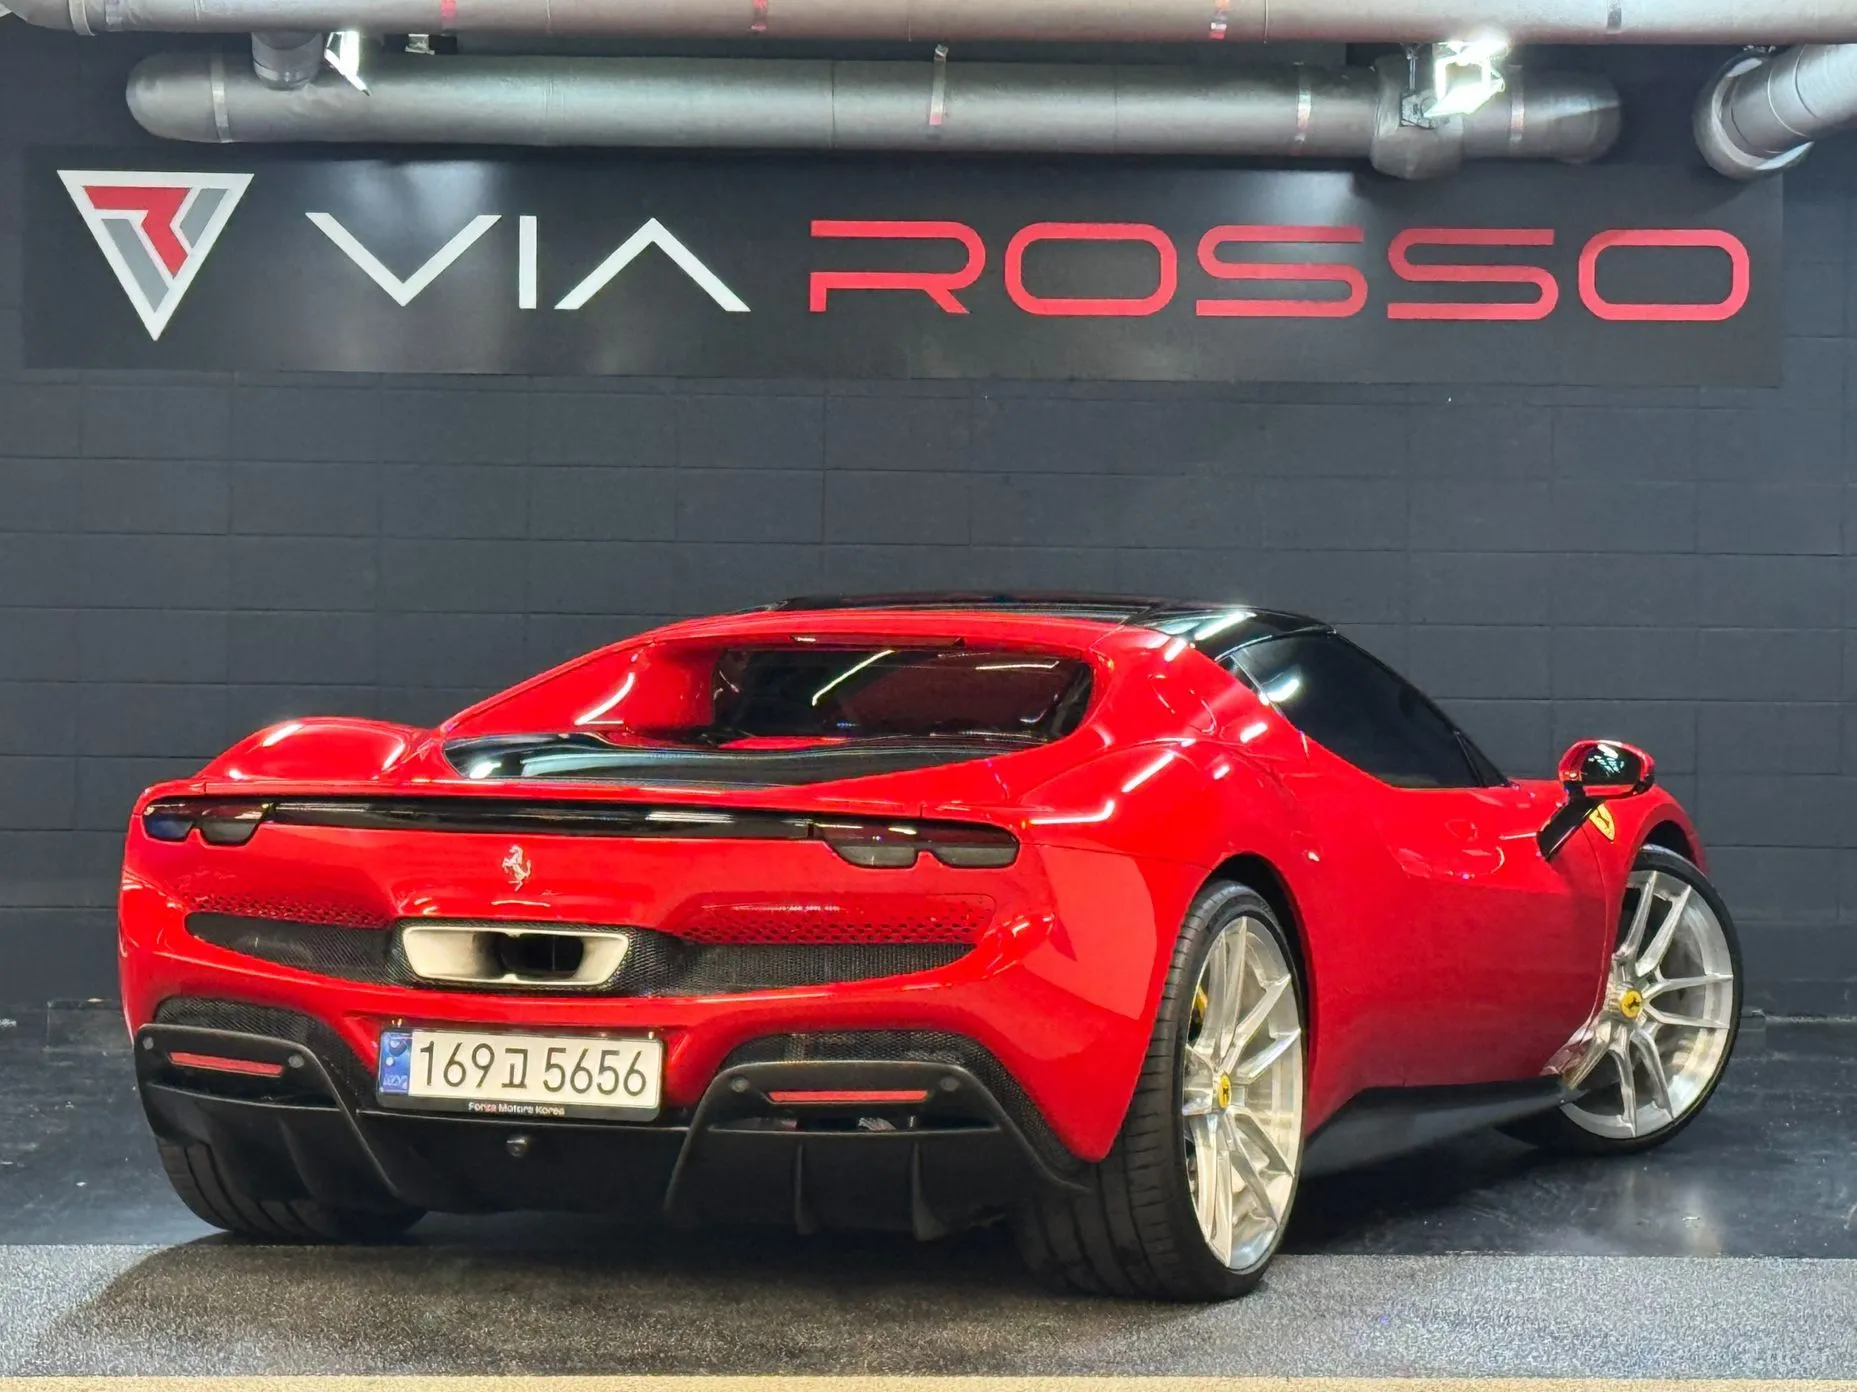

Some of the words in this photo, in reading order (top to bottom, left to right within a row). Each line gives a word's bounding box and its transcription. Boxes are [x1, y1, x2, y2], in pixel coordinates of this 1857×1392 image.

[305, 212, 750, 313] VIA
[808, 219, 1750, 322] ROSSO
[419, 1040, 529, 1089] 169고
[542, 1046, 647, 1096] 5656
[498, 1103, 534, 1116] Motors
[535, 1105, 566, 1117] Korea
